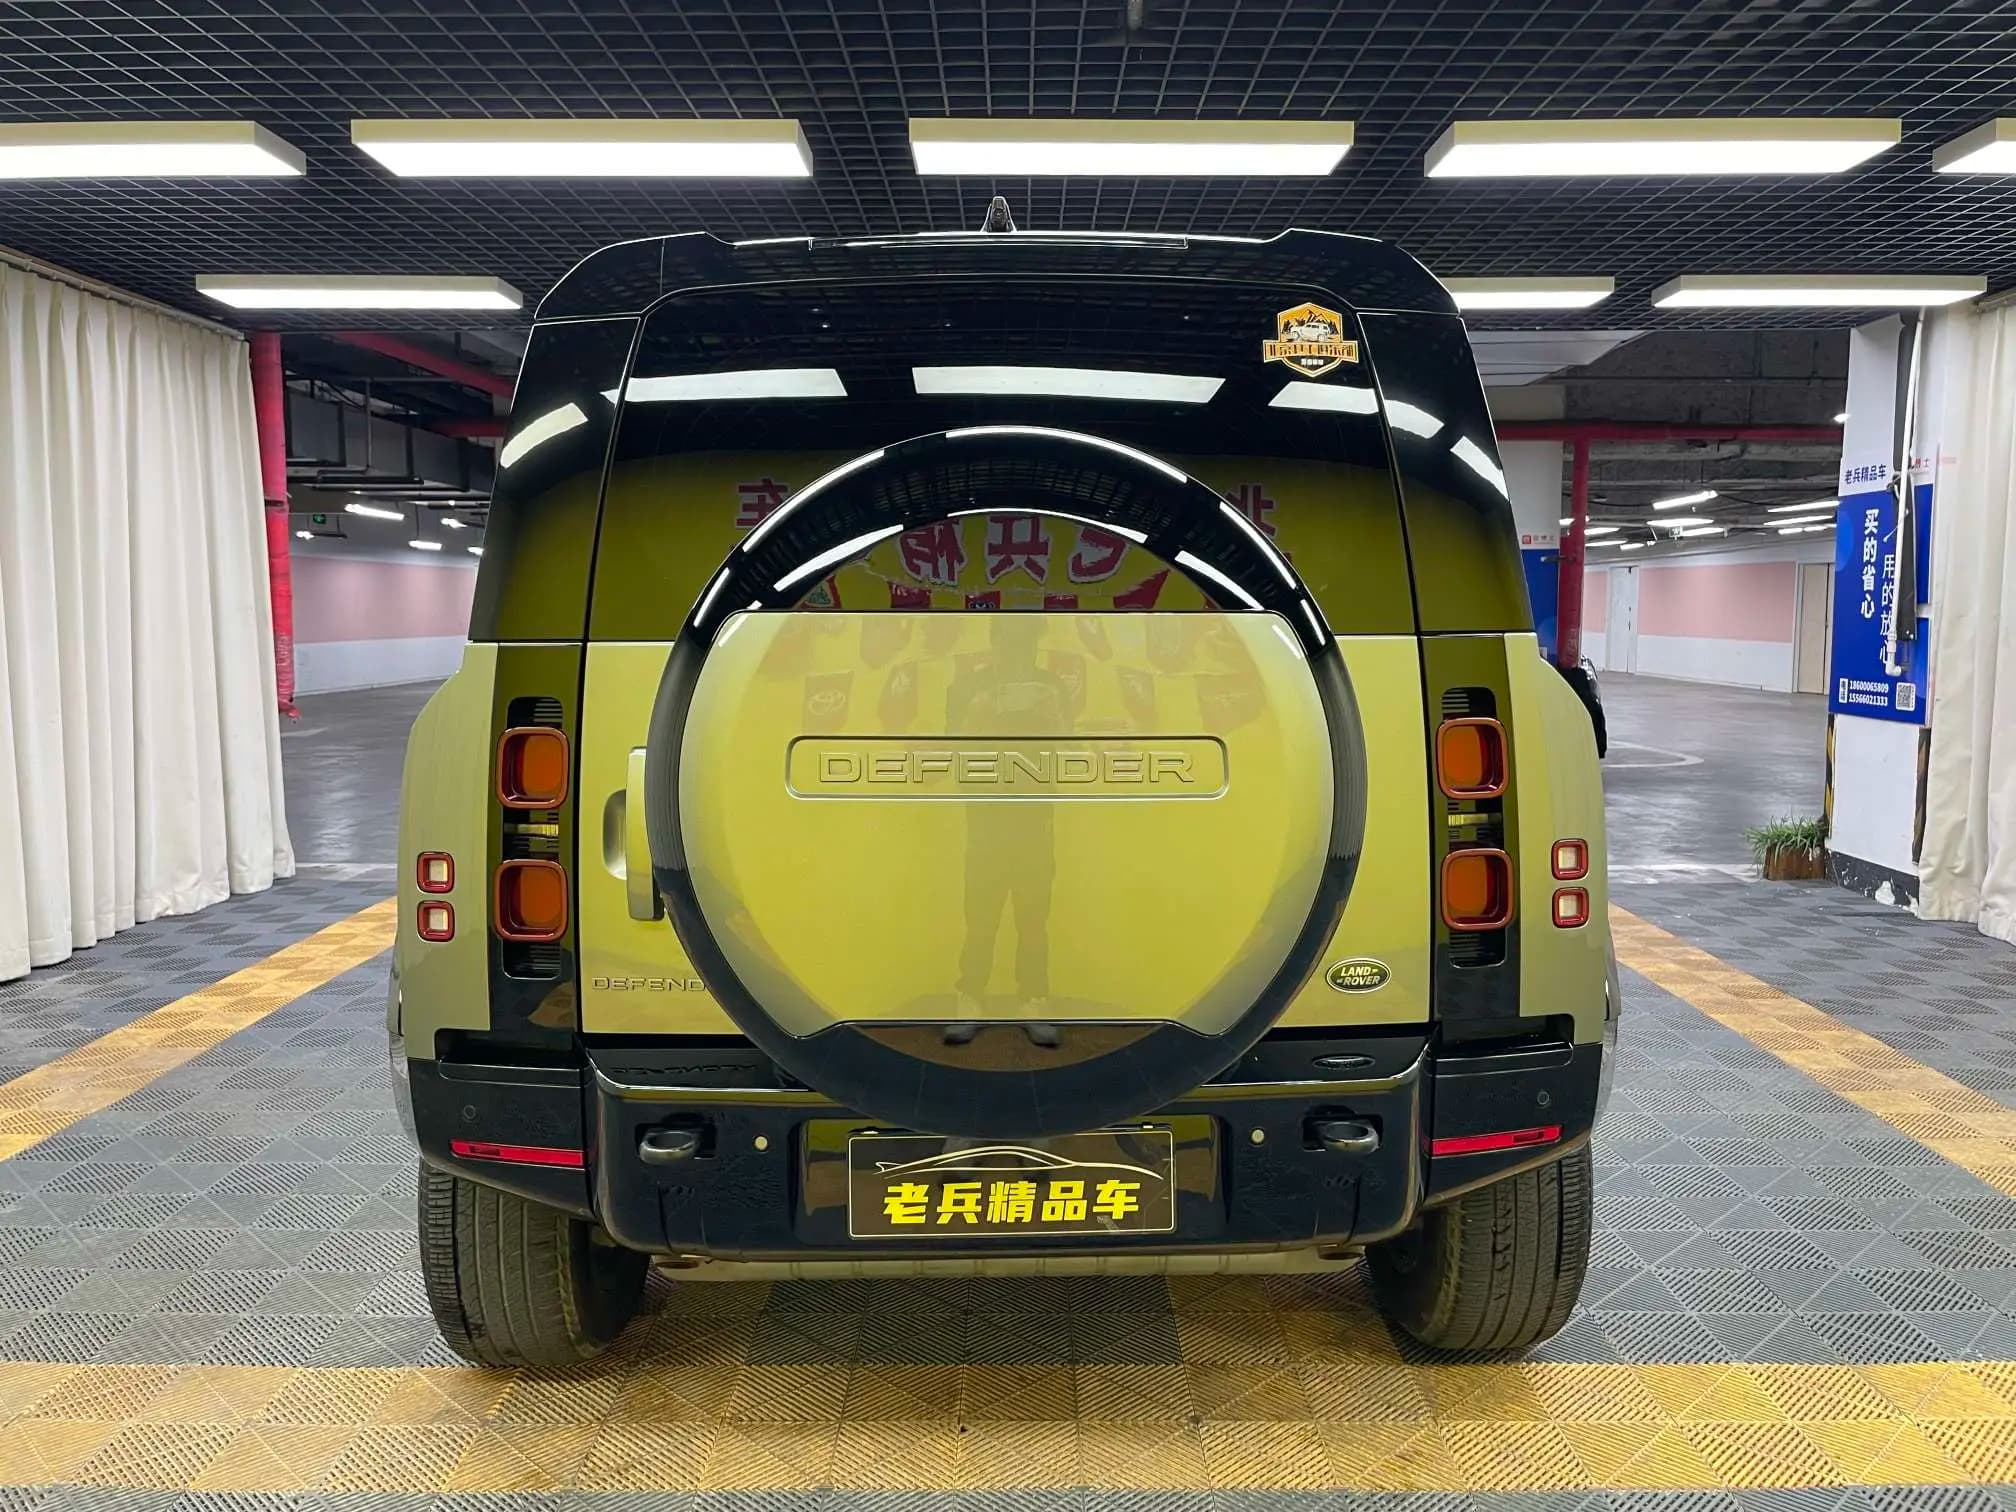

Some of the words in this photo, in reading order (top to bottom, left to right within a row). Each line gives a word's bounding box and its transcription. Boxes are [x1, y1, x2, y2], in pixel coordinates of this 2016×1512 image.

[1844, 463, 1887, 485] 老兵精品车
[1860, 508, 1880, 620] 买的省心
[819, 751, 1195, 783] DEFENDER
[1340, 966, 1372, 977] LAND
[1342, 975, 1381, 986] ROVER
[883, 1179, 1141, 1225] 老兵精品车
